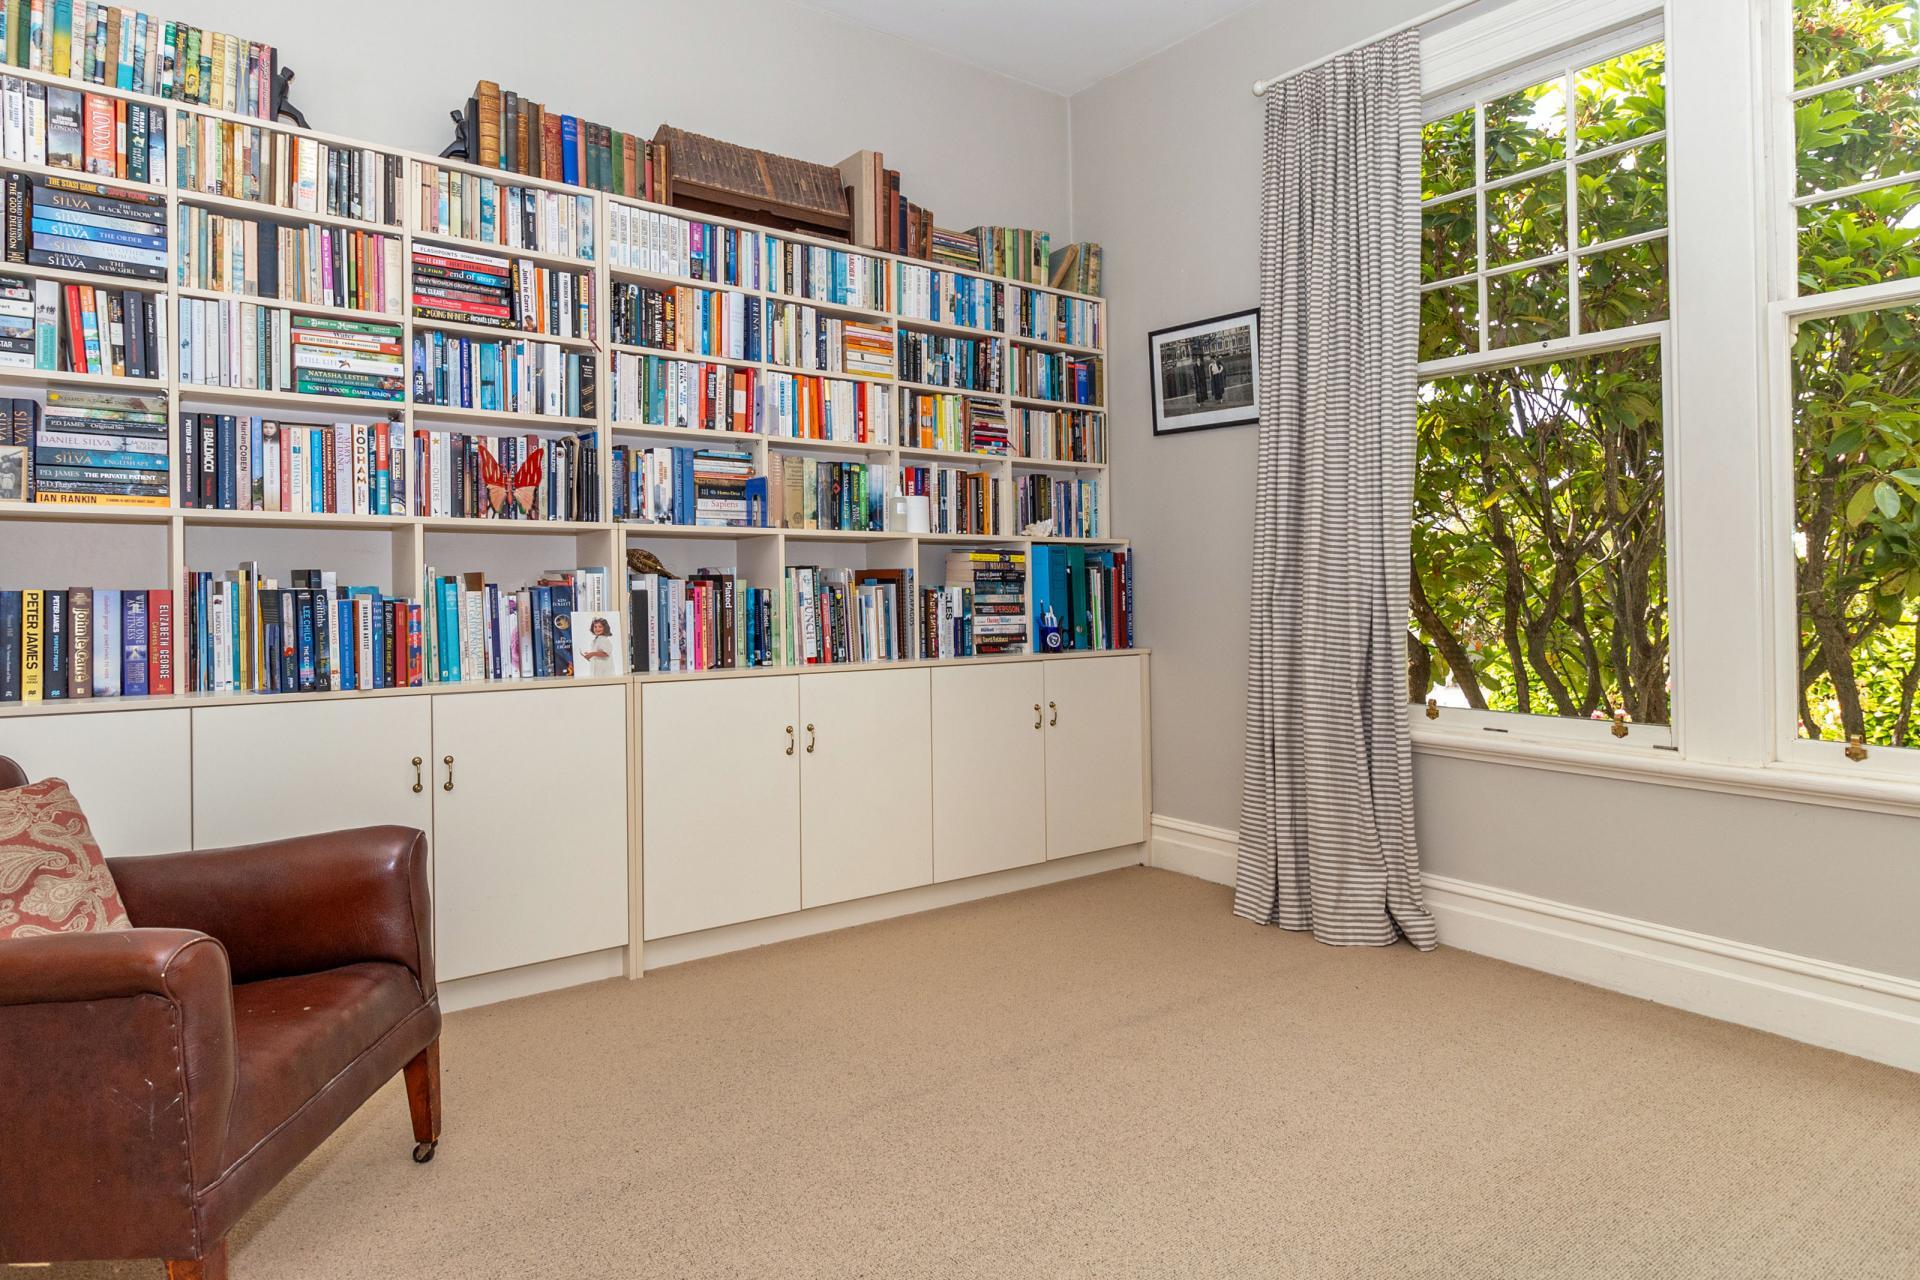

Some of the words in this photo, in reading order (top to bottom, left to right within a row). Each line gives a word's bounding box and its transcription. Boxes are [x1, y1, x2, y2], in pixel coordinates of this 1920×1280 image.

[132, 106, 141, 136] HURLEY
[92, 111, 111, 154] LONDON
[9, 182, 17, 196] THE
[48, 176, 61, 186] THE
[61, 178, 79, 189] STASI
[9, 197, 17, 213] GOD
[53, 196, 91, 209] SILVA
[98, 205, 122, 214] BLACK
[122, 210, 152, 218] WIDOW
[9, 215, 17, 249] DELUSION
[52, 226, 90, 239] SILVA
[116, 235, 143, 244] ORDER
[420, 247, 458, 257] FLASHPOINTS
[48, 256, 87, 269] SILVA
[118, 267, 137, 275] GIRL
[476, 275, 497, 285] story
[308, 370, 343, 379] NATASHA
[343, 373, 369, 382] LESTER
[14, 410, 27, 445] SILVA
[63, 420, 86, 428] JAMES
[40, 435, 78, 445] DANIEL
[82, 437, 112, 447] SILVA
[336, 426, 344, 445] LAST
[55, 454, 93, 464] SILVA
[203, 432, 215, 473] BALDACCI
[336, 446, 344, 473] DANCE
[343, 436, 351, 465] MARY'S
[356, 426, 367, 484] RODHAM
[54, 470, 81, 478] JAMES
[83, 471, 99, 479] THE
[100, 472, 128, 480] PRIVATE
[432, 467, 440, 502] OUTLIERS
[39, 494, 58, 503] IAN
[60, 494, 98, 504] RANKIN
[126, 599, 135, 608] AS
[724, 581, 733, 608] Plated
[26, 592, 39, 629] PETER
[52, 595, 60, 614] PETER
[135, 595, 145, 614] WITH
[316, 594, 326, 628] Griffiths
[52, 614, 60, 633] JAMES
[72, 608, 90, 637] John
[127, 608, 135, 640] WITNESS
[135, 616, 145, 627] NO
[159, 604, 169, 646] ELIZABETH
[804, 597, 815, 640] PUNCH
[74, 637, 90, 649] le
[135, 628, 145, 645] ONE
[26, 632, 39, 670] JAMES
[73, 649, 89, 683] Carré
[159, 649, 170, 679] GEORGE
